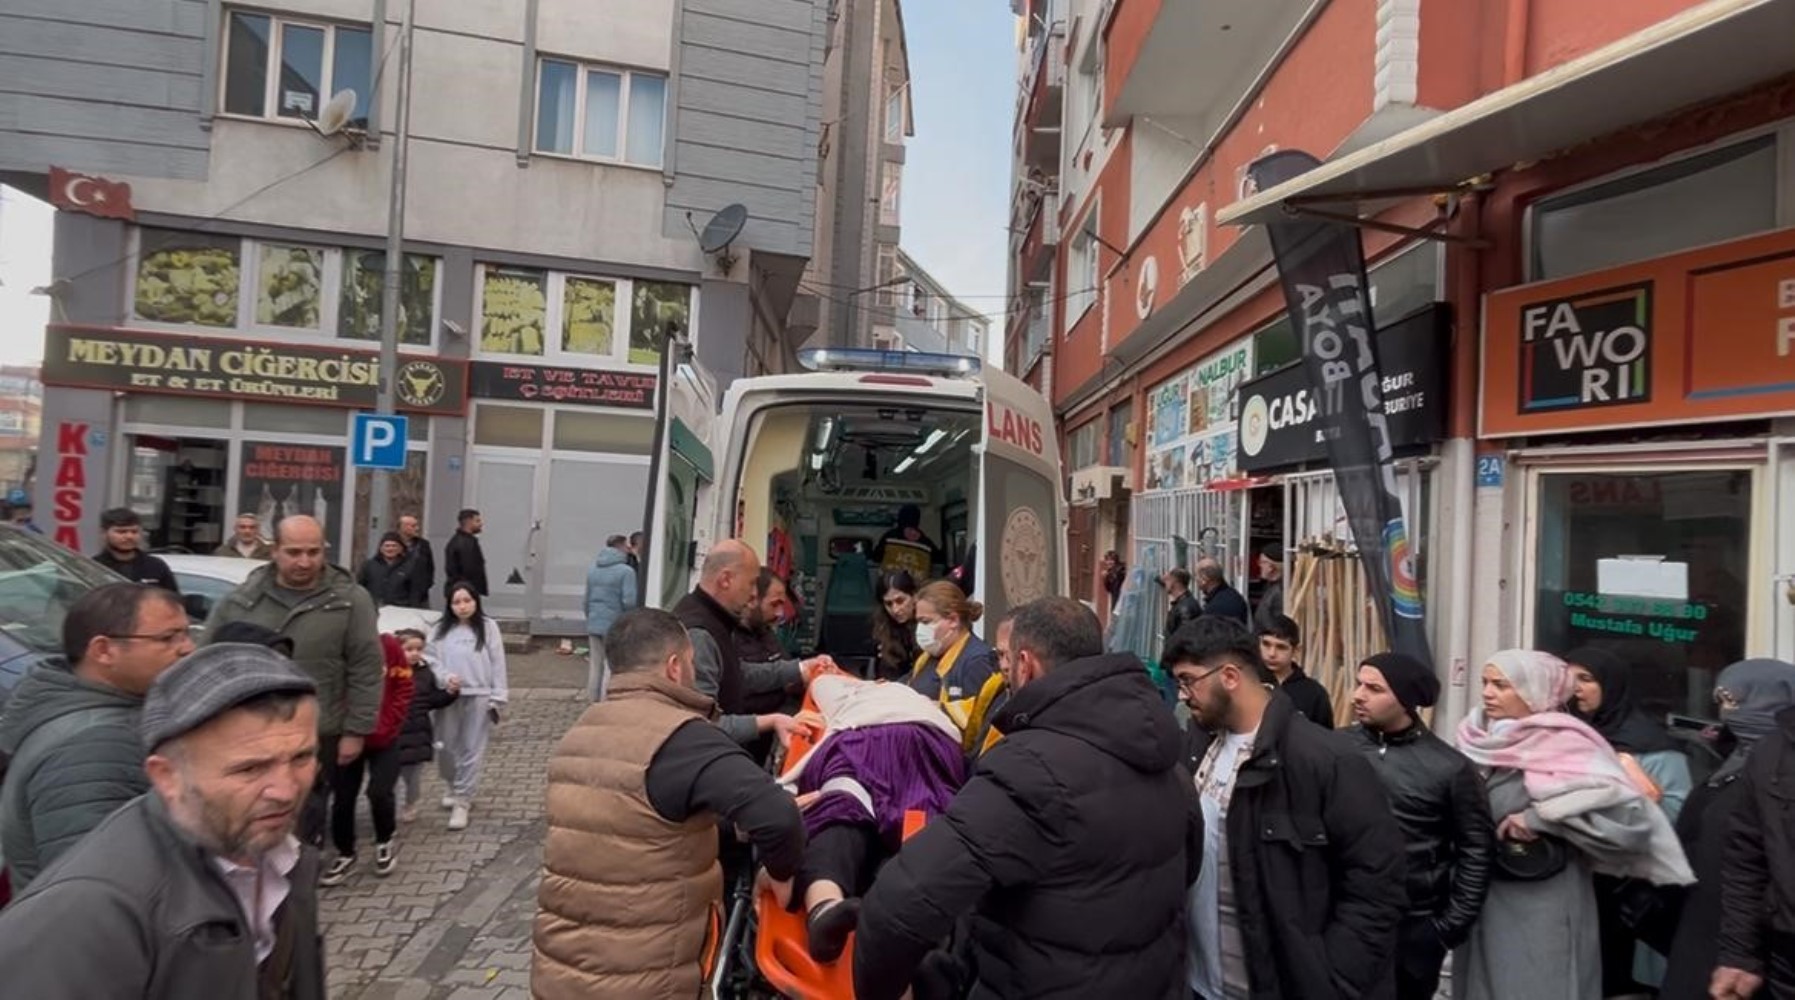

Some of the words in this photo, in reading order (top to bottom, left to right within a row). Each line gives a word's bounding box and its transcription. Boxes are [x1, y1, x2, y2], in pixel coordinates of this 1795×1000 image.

[68, 338, 212, 373] MEYDAN
[219, 346, 380, 386] CİĞERCİSİ
[503, 367, 536, 380] ET
[543, 370, 575, 383] VE
[1199, 349, 1247, 385] NALBUR
[130, 373, 162, 387] ET
[167, 376, 189, 389] &
[193, 378, 224, 391] ET
[230, 378, 339, 400] ÜRÜNLERİ
[1382, 372, 1414, 394] ĞUR
[363, 420, 396, 462] P
[986, 401, 1043, 454] LANS
[254, 445, 332, 462] MEYDAN
[1479, 459, 1500, 475] 2A
[1571, 613, 1643, 635] Mustafa
[1648, 622, 1699, 642] Uğur
